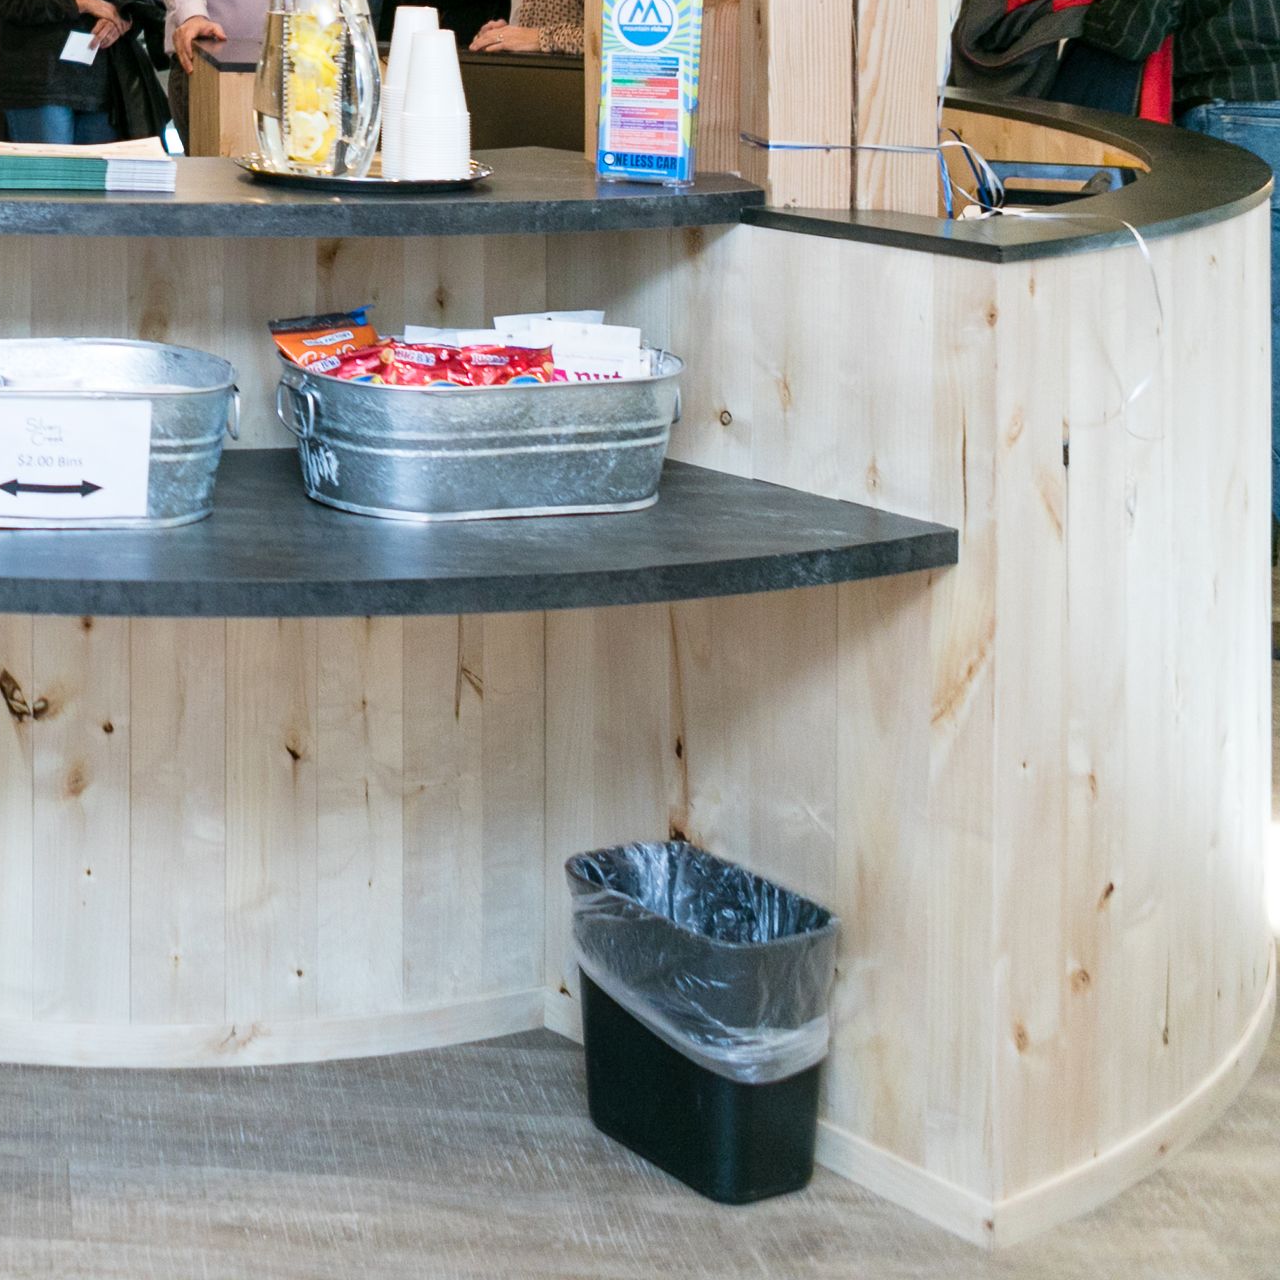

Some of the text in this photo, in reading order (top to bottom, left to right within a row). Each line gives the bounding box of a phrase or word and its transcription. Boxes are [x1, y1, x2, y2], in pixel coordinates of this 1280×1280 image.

[603, 151, 629, 166] ONE
[630, 154, 653, 168] LESS
[656, 156, 678, 170] CAR
[17, 454, 84, 468] $2.00 Bins
